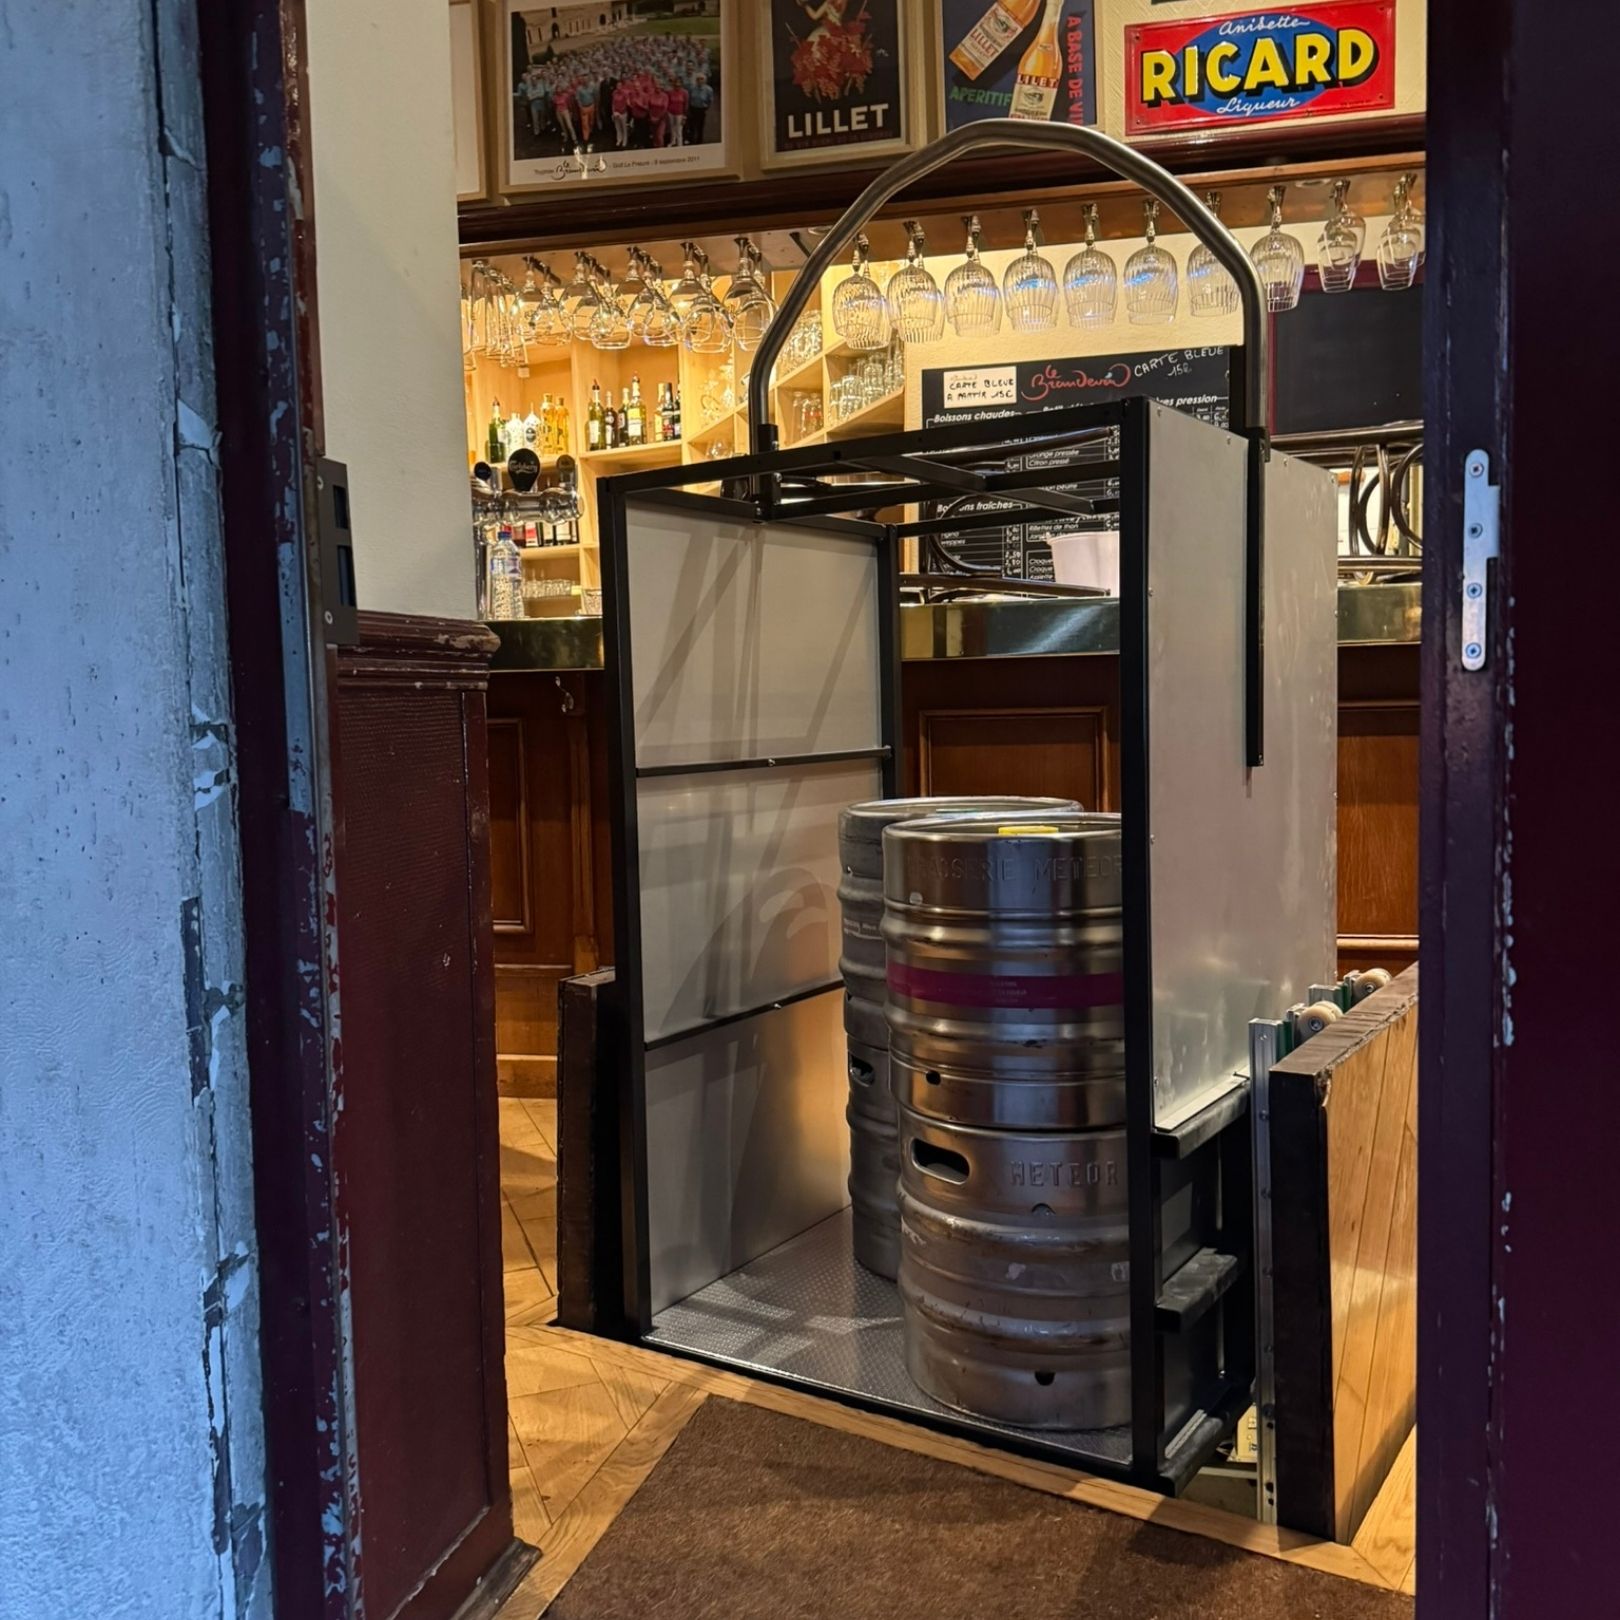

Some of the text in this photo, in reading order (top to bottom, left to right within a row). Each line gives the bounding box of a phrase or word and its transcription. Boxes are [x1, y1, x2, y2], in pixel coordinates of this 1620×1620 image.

[1067, 16, 1082, 28] A
[1067, 31, 1083, 73] BASE
[1142, 28, 1377, 103] RICARD
[949, 86, 1012, 106] APERITIF
[1068, 79, 1083, 98] DE
[1216, 97, 1301, 117] Liqueur
[788, 103, 889, 138] LILLET
[1134, 345, 1224, 377] CARTE BLEUE
[1175, 394, 1218, 408] pression
[933, 409, 1015, 423] Boissons chaudes
[1009, 1160, 1119, 1187] METEOR
